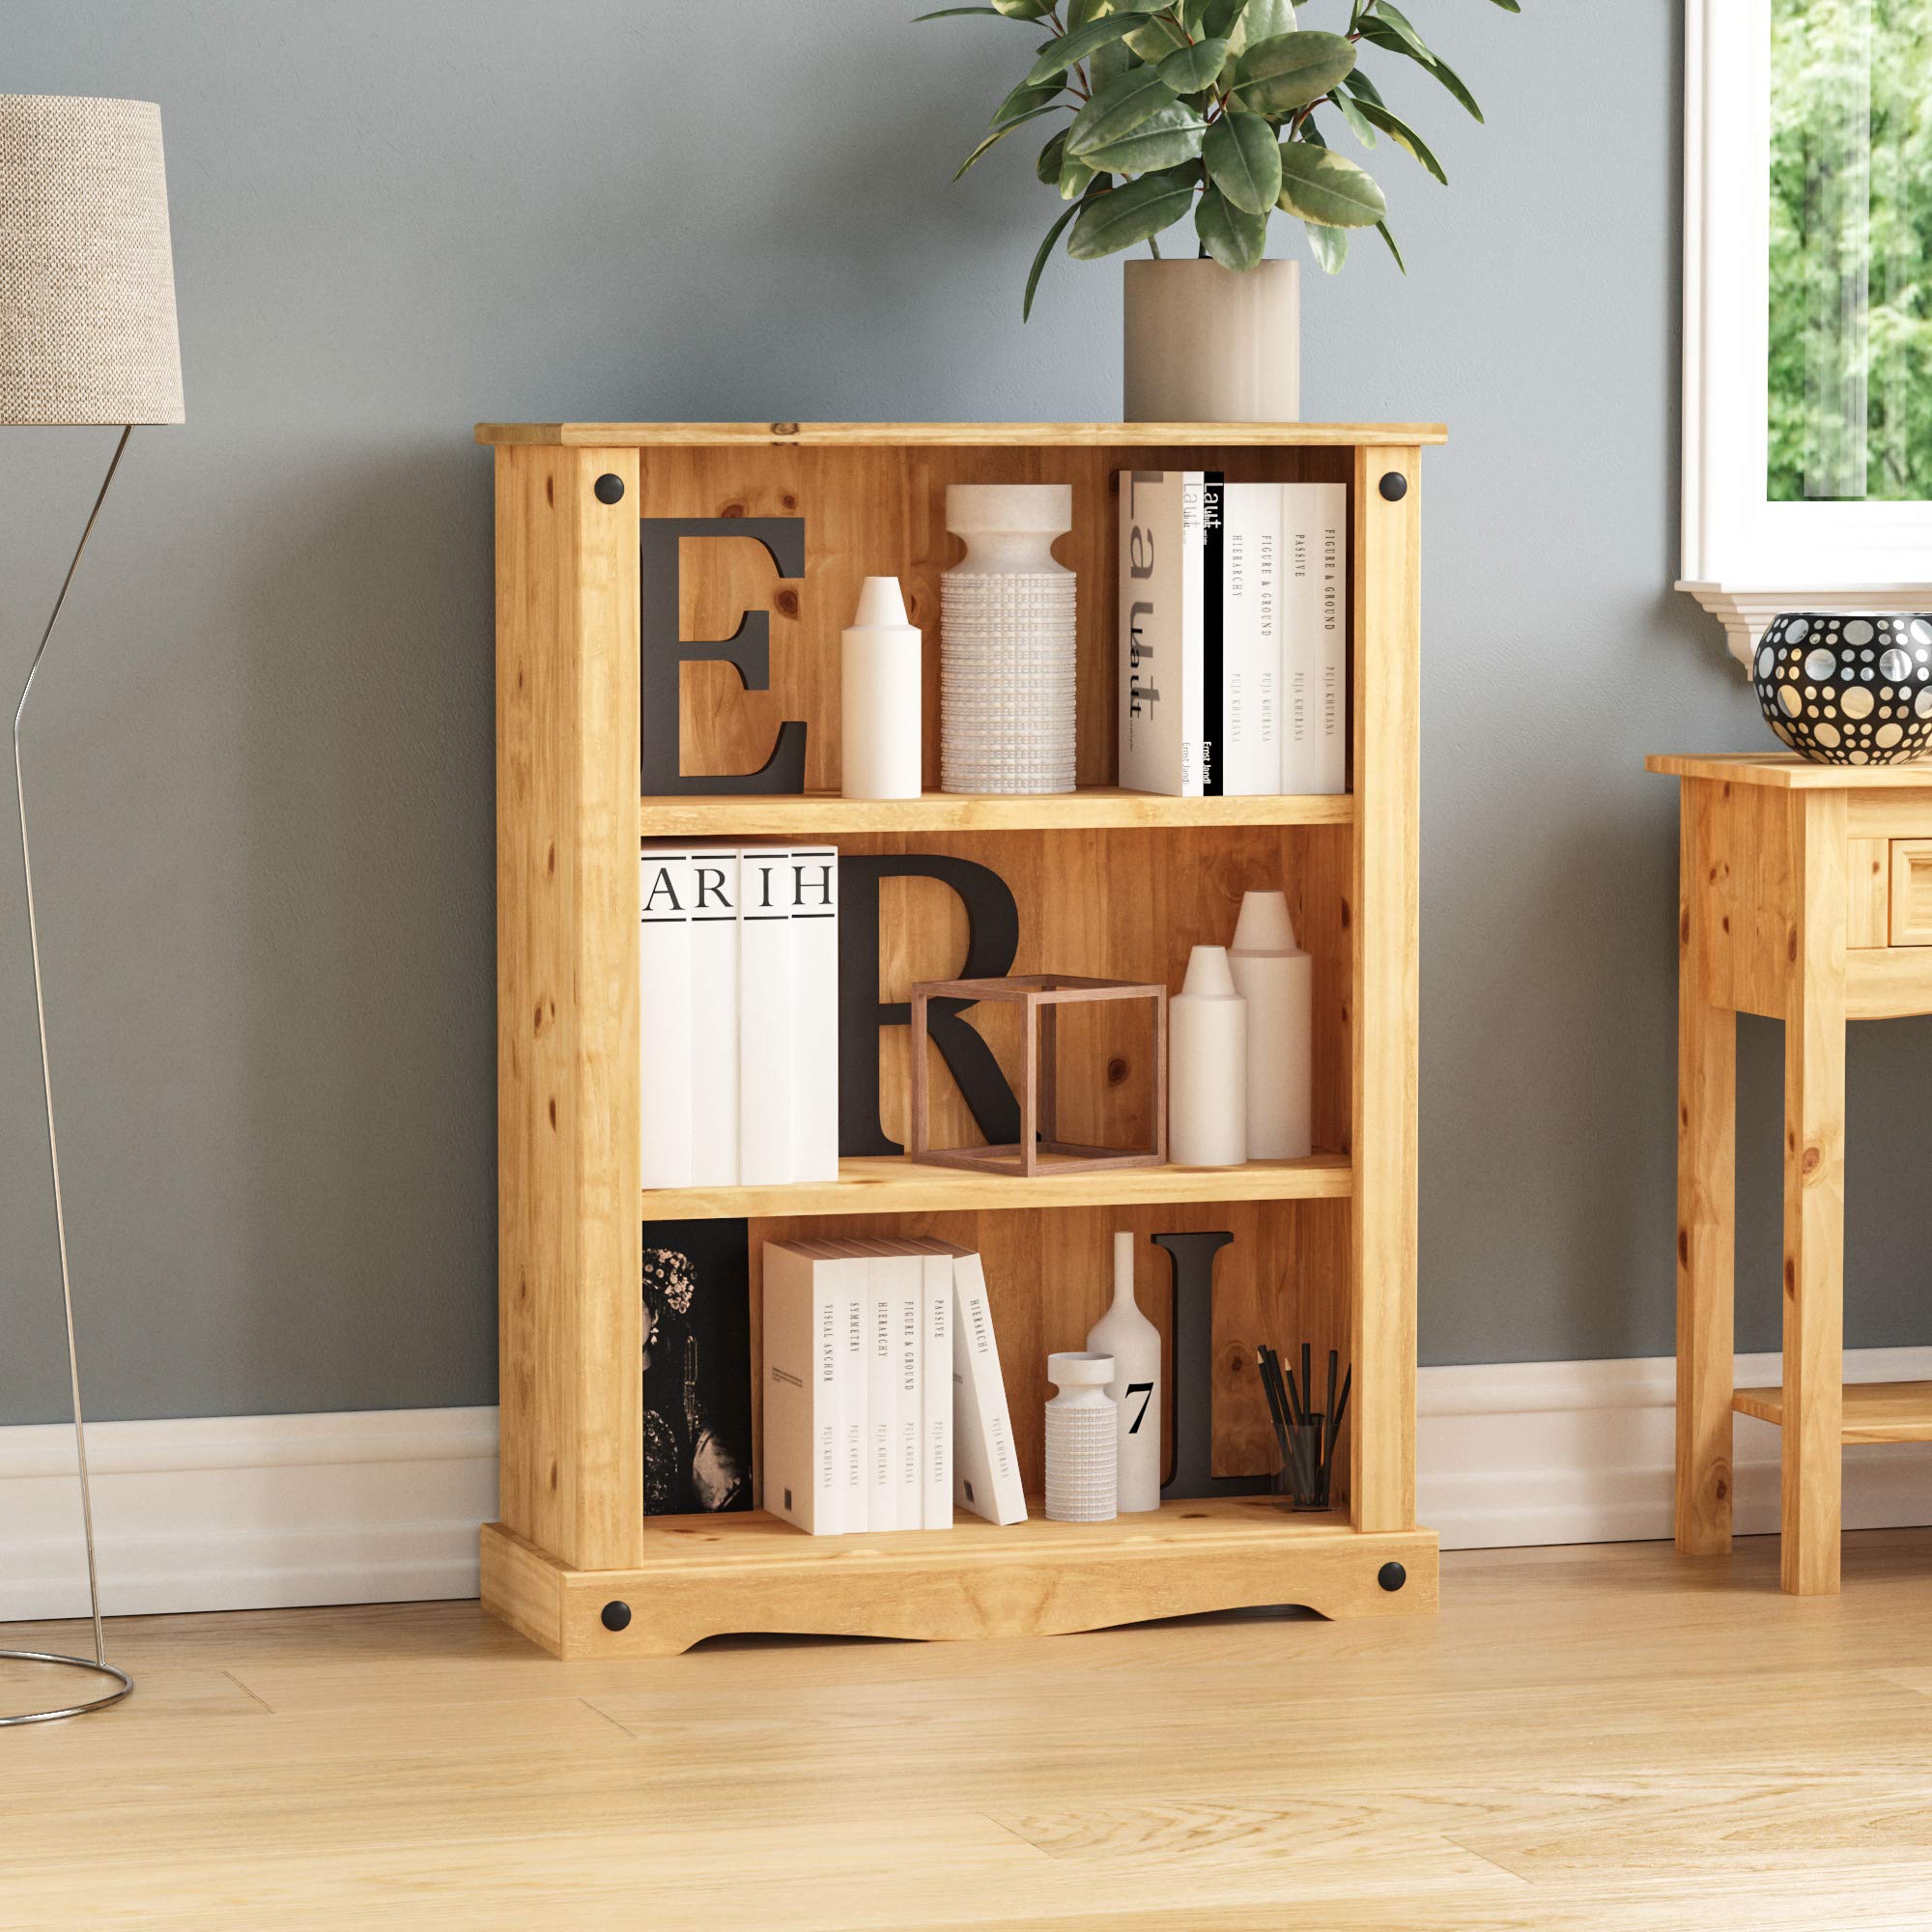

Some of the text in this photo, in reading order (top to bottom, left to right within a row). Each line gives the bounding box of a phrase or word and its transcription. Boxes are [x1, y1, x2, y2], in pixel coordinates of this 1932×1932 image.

[1204, 483, 1223, 528] Laut
[1233, 535, 1242, 596] HIERARCHY
[1262, 536, 1271, 574] FIGURE
[1295, 535, 1305, 577] PASSIVE
[1325, 529, 1335, 568] FIGURE
[1262, 593, 1271, 636] GROUND
[1325, 587, 1335, 629] GROUND
[639, 518, 807, 796] E
[1204, 742, 1212, 784] Ernst Jandl
[838, 854, 1041, 1157] R
[850, 1303, 859, 1351] SYMMETRY
[878, 1302, 888, 1355] HIERARCHY
[904, 1302, 914, 1335] FIGURE
[935, 1300, 944, 1337] PASSIVE
[970, 1299, 989, 1354] HIERARCHY
[824, 1305, 833, 1381] VISUAL ANCHOR
[904, 1352, 914, 1390] GROUND
[1125, 1382, 1154, 1435] 7
